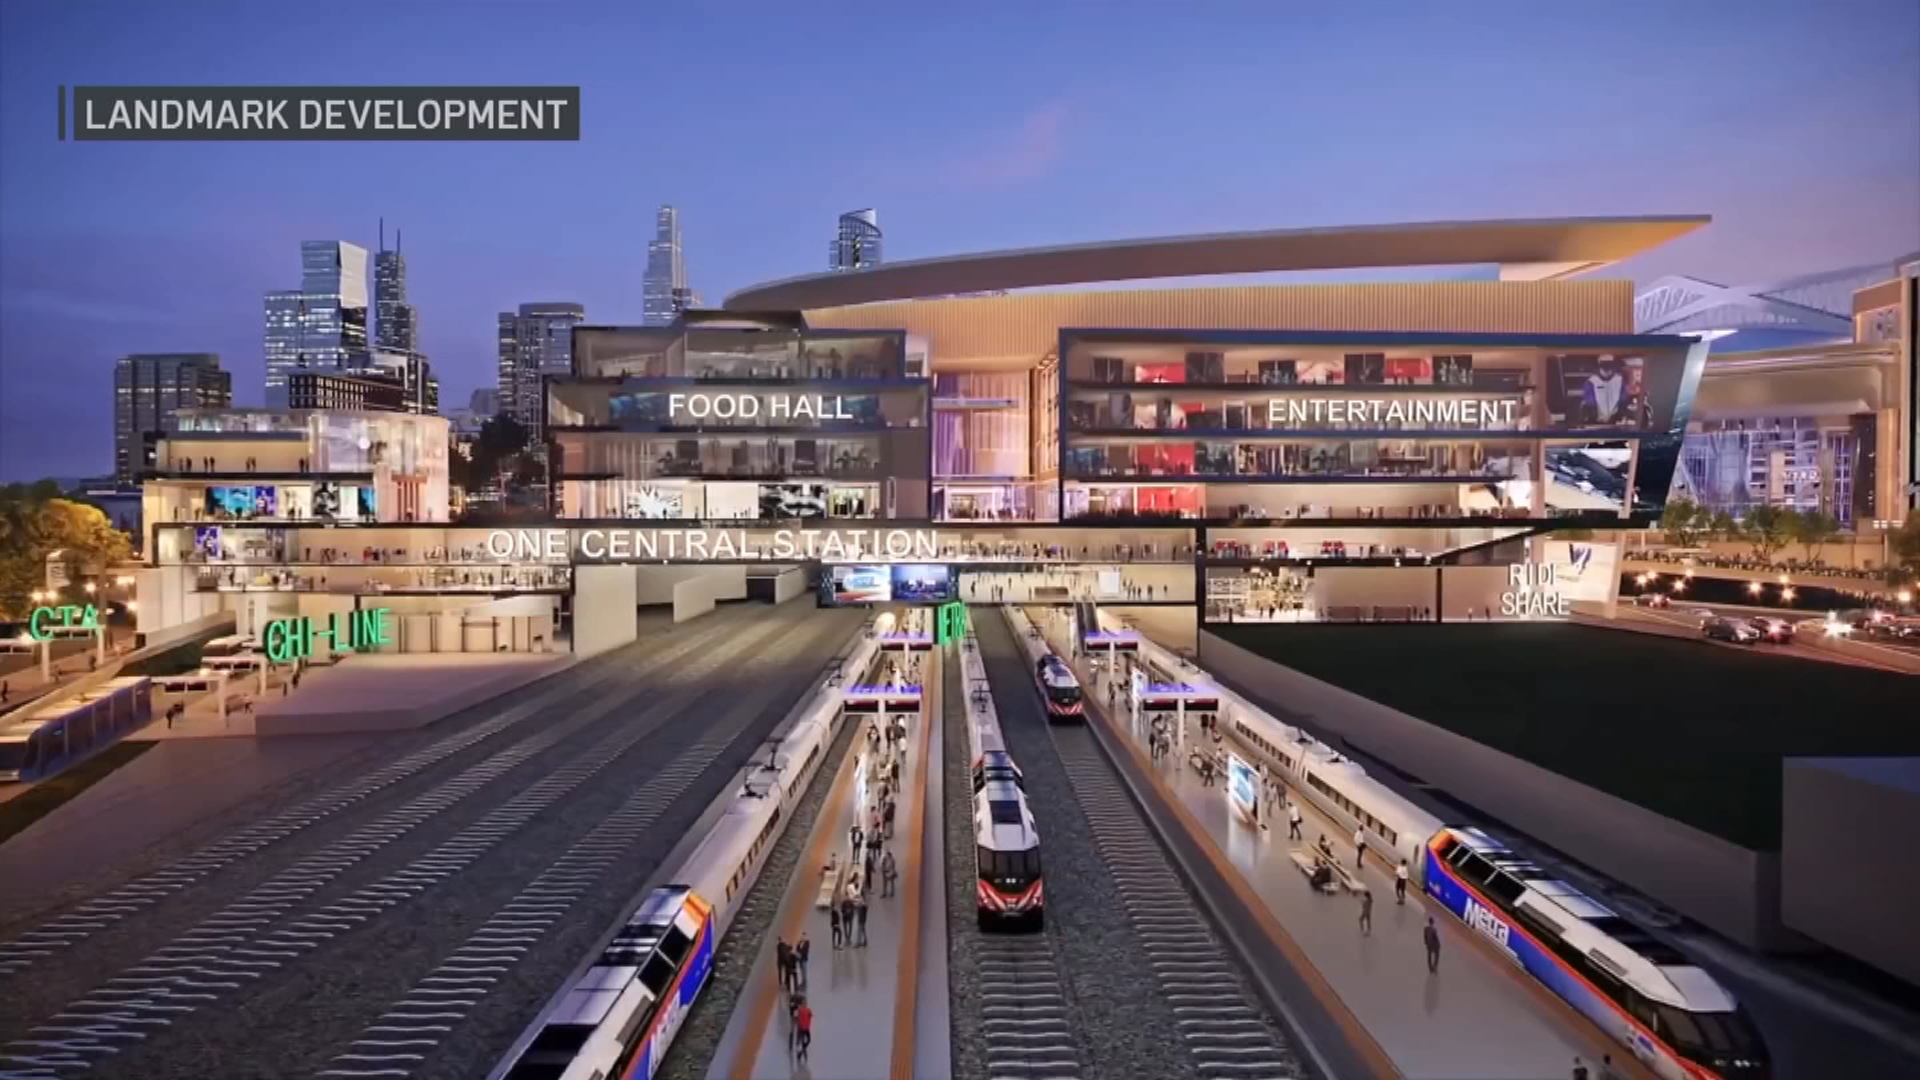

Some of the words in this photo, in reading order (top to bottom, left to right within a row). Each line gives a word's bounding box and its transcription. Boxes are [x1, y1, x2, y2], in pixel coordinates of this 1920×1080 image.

[669, 394, 759, 418] FOOD
[771, 395, 854, 419] HALL
[1268, 399, 1517, 423] ENTERTAINMENT
[487, 530, 567, 558] ONE
[581, 530, 759, 558] CENTRAL
[773, 530, 937, 558] STATION
[1500, 591, 1570, 616] SHARE
[30, 603, 99, 641] CTA
[263, 607, 391, 663] CHI-LINE
